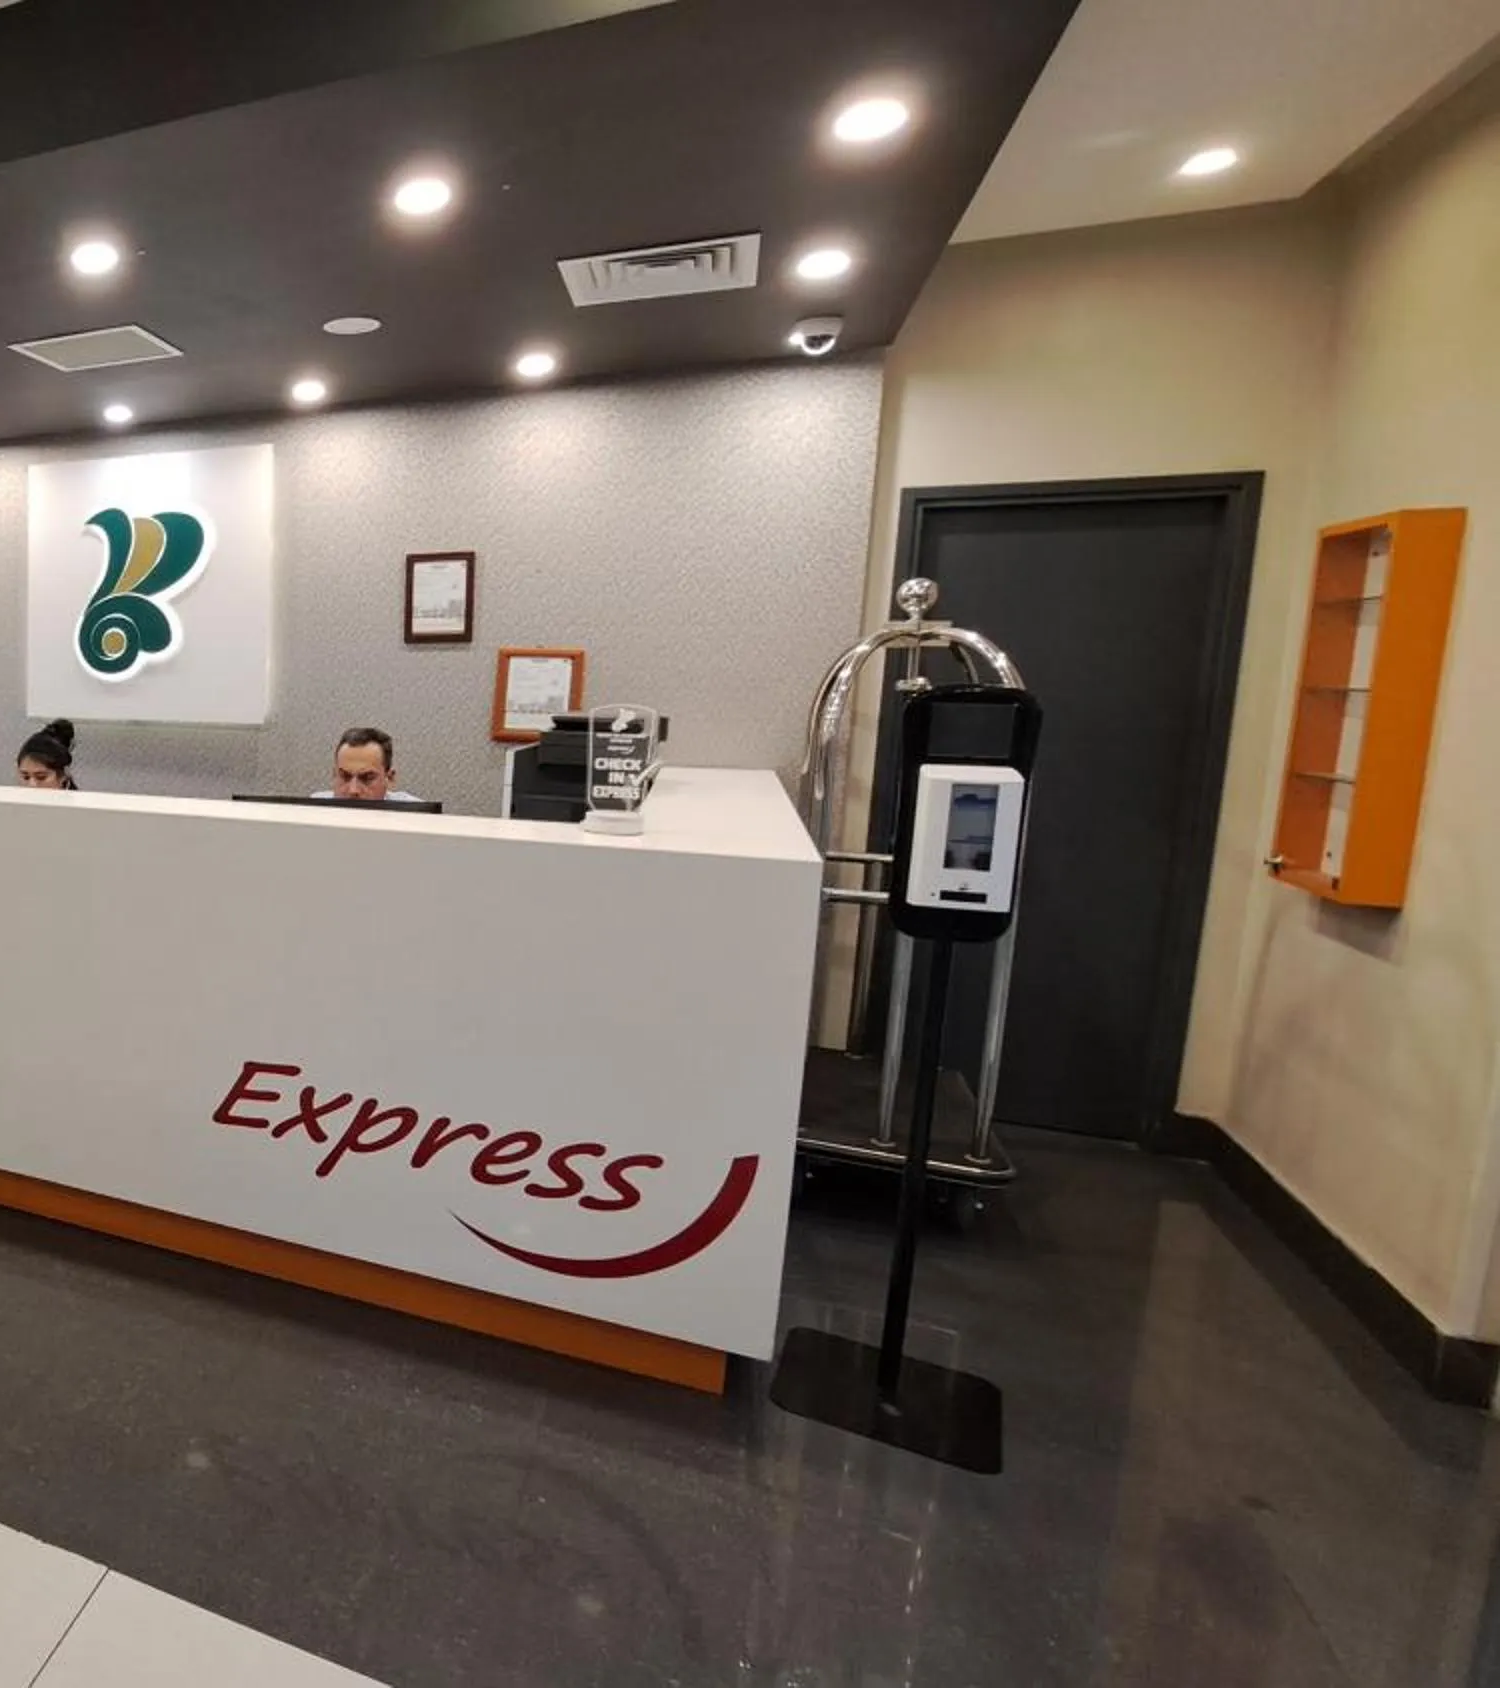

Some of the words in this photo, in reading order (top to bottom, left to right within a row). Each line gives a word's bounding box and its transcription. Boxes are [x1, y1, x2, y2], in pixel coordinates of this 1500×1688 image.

[595, 757, 642, 771] CHECK
[608, 771, 625, 784] IN
[212, 1061, 664, 1212] Express
